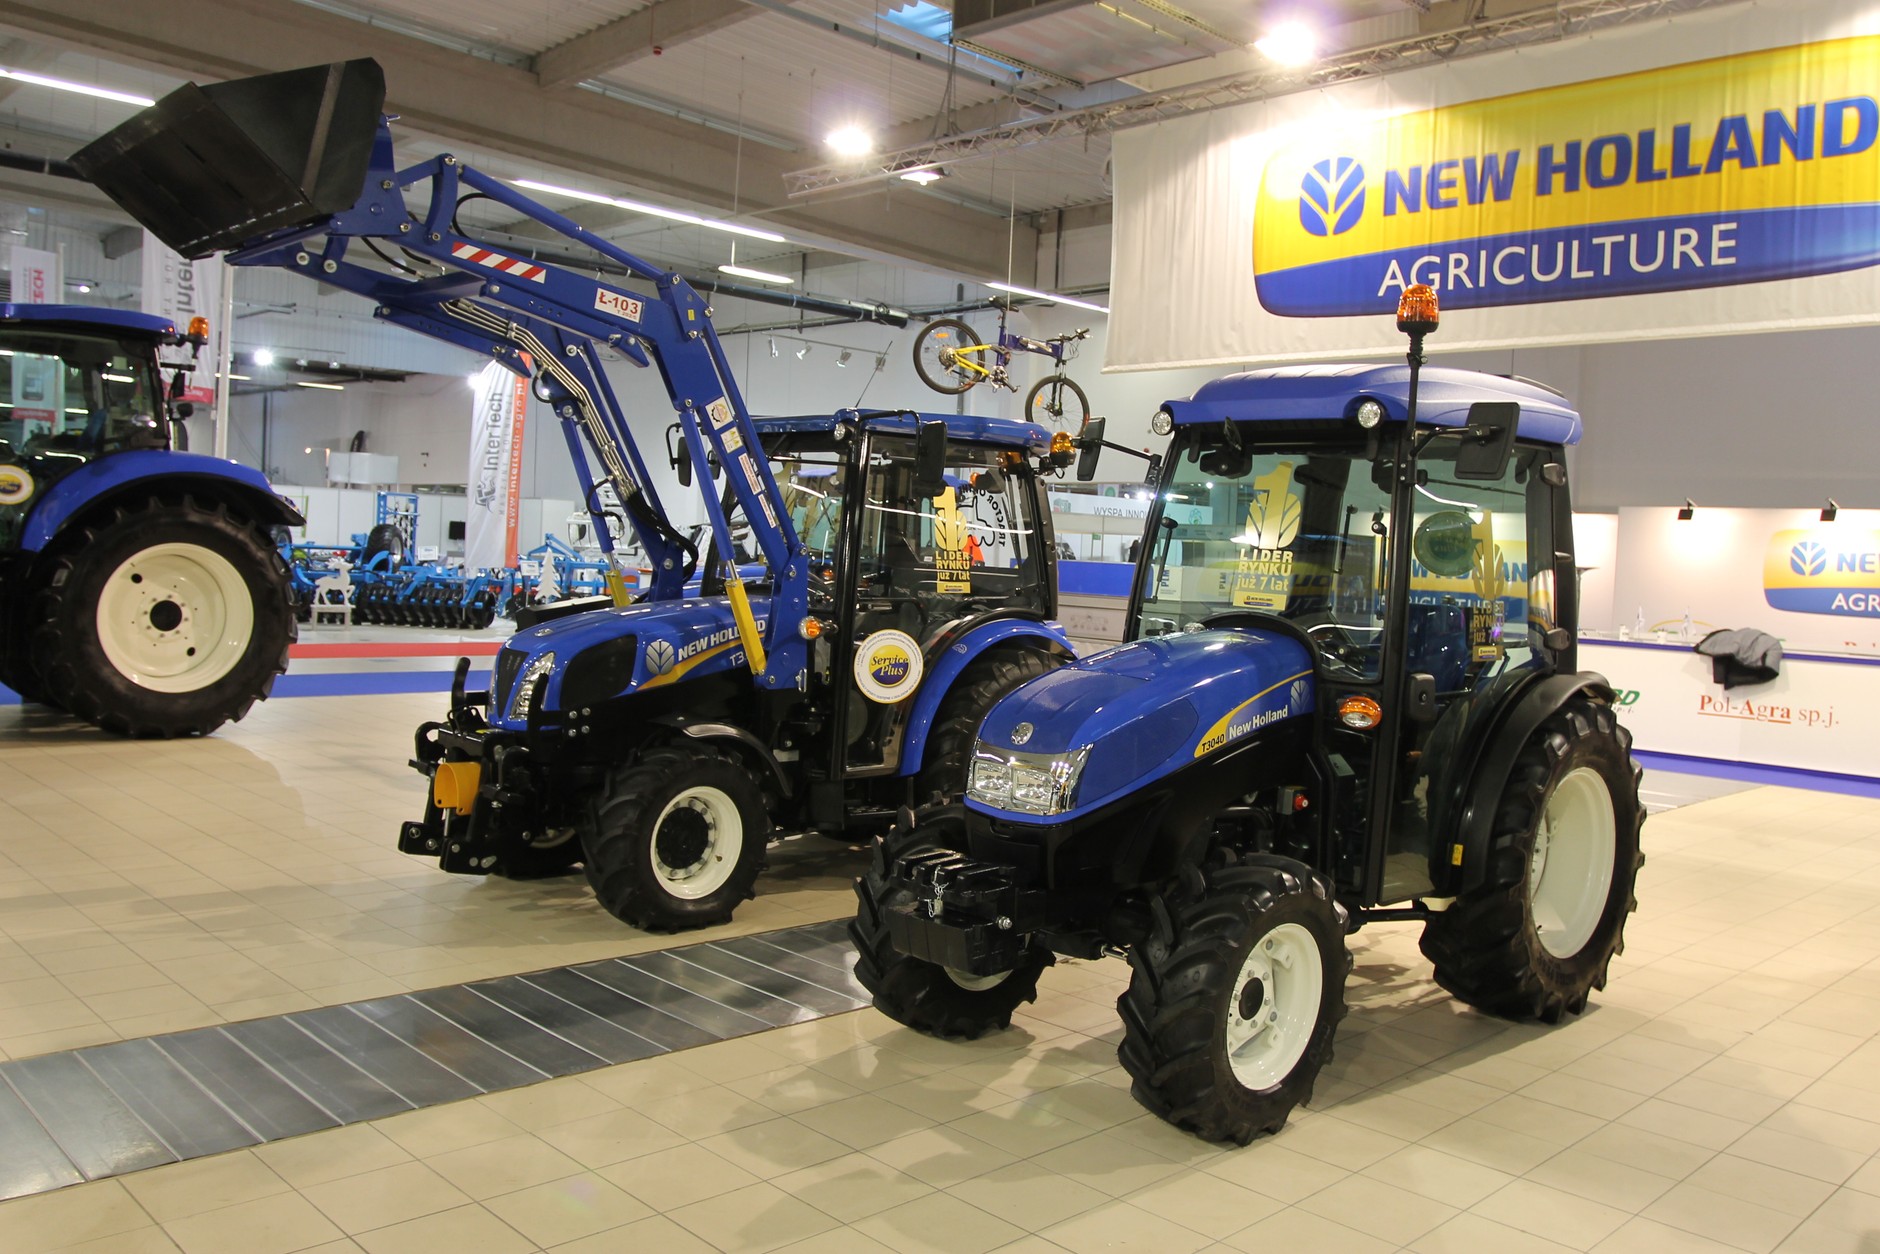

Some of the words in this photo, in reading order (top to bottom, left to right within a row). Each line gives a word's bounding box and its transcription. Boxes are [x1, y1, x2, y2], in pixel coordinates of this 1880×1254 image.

[1382, 148, 1521, 217] NEW
[1535, 95, 1878, 197] HOLLAND
[1377, 222, 1738, 297] AGRICULTURE
[598, 291, 639, 314] Ł-103
[1125, 508, 1147, 519] INNO
[935, 550, 970, 561] LIDER
[1240, 548, 1294, 563] LIDER
[1836, 552, 1880, 573] NE
[936, 560, 970, 570] RYNKU
[1238, 561, 1293, 577] RYNKU
[1235, 575, 1257, 590] już
[1260, 576, 1269, 590] 7
[1270, 576, 1290, 592] lat
[1831, 592, 1880, 612] AGR
[678, 636, 709, 662] NEW
[710, 619, 766, 647] HOLLD
[729, 650, 746, 667] T3
[871, 654, 909, 666] Service
[880, 664, 904, 676] Plus
[1699, 694, 1791, 721] Pol-Agra
[1797, 705, 1839, 728] sp.j.
[1201, 733, 1225, 753] T3040
[1228, 720, 1252, 740] New
[1252, 704, 1289, 729] Holland
